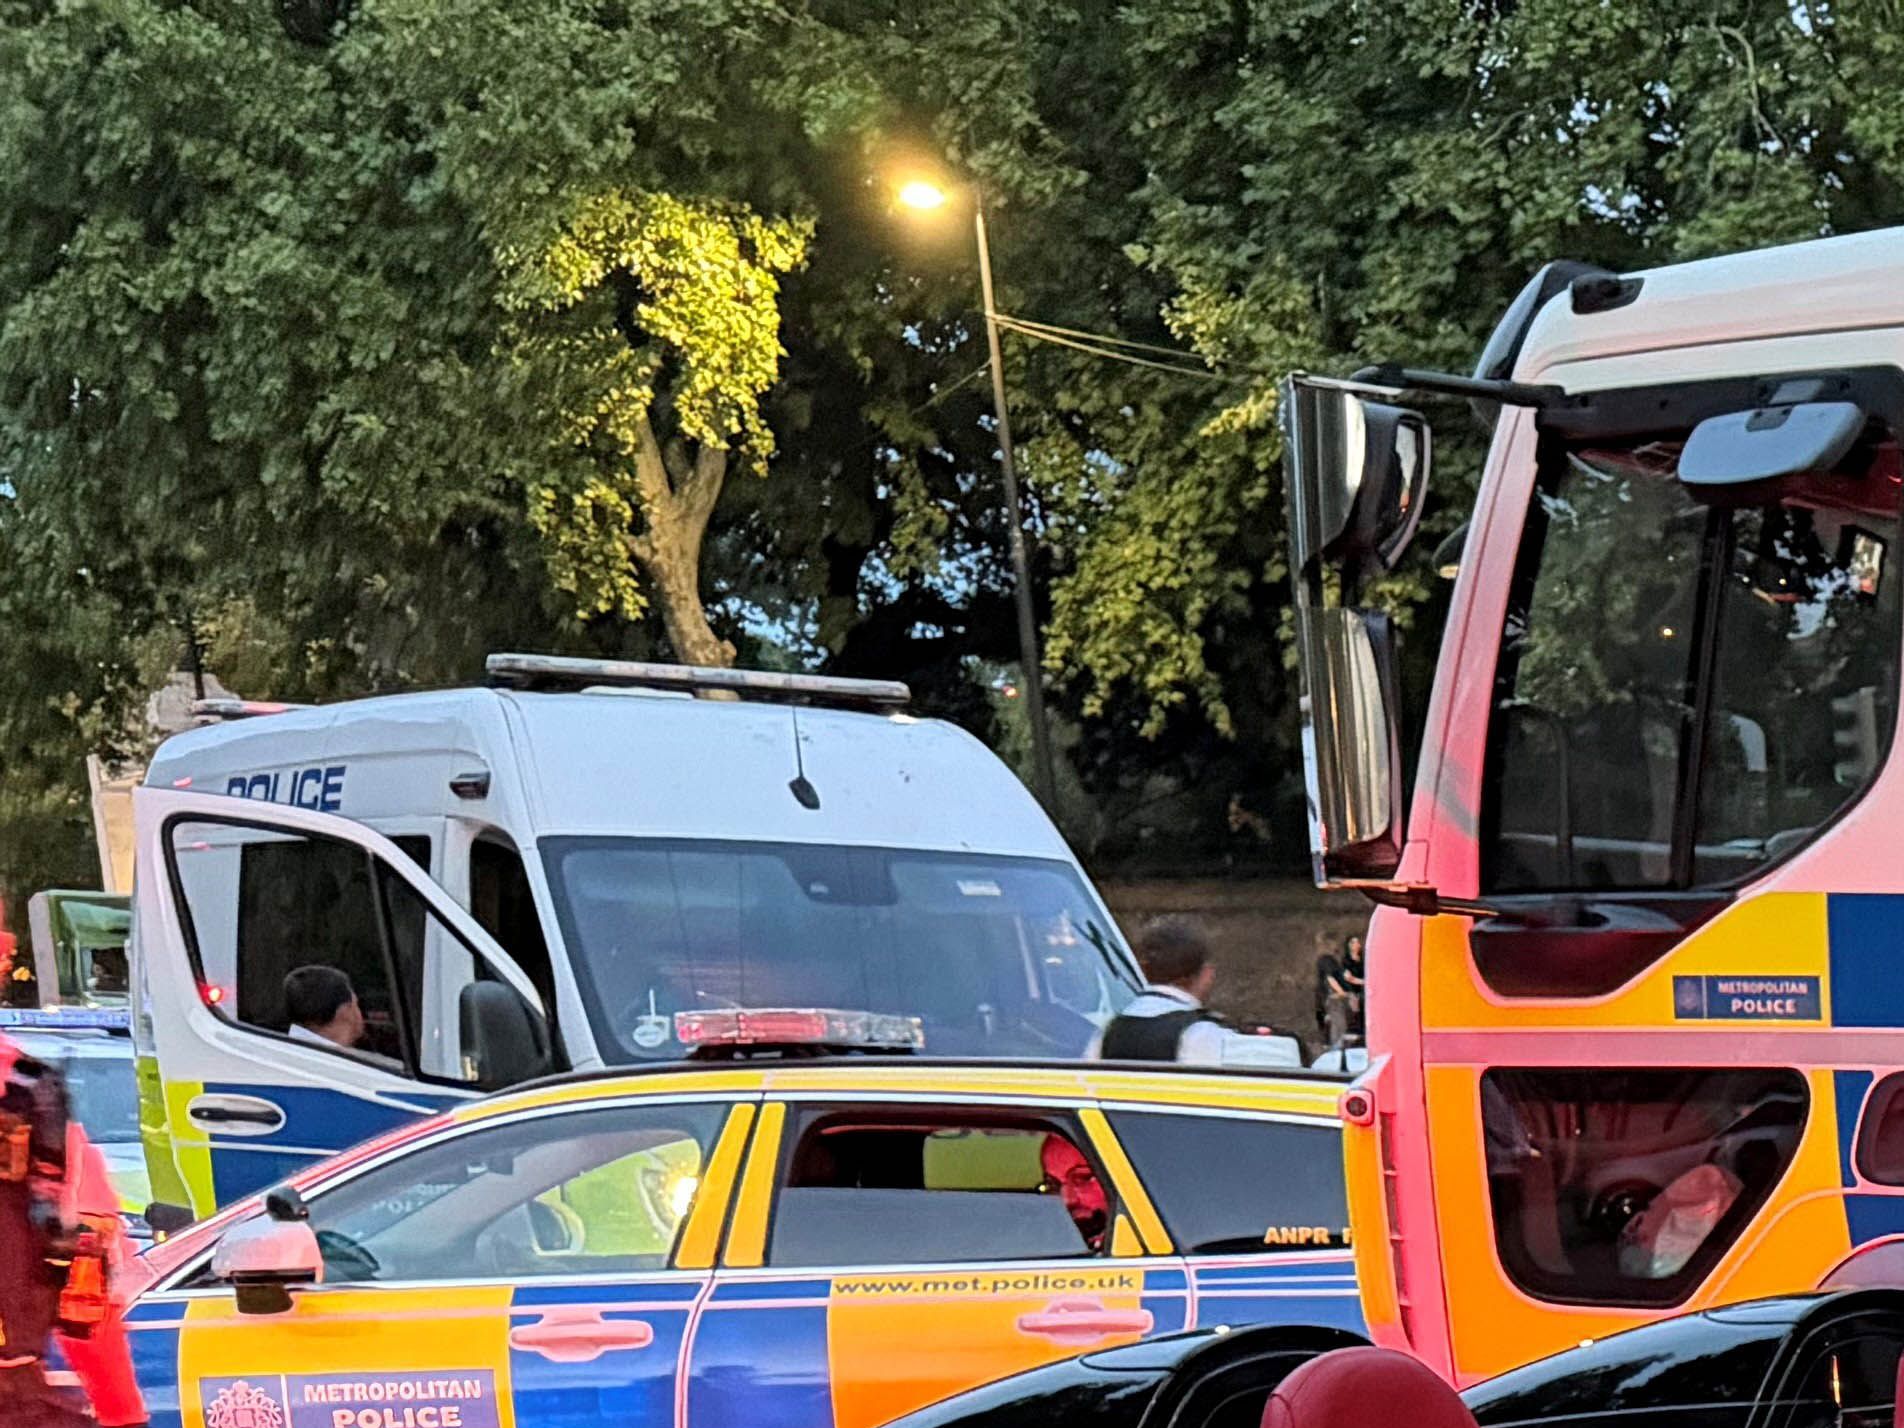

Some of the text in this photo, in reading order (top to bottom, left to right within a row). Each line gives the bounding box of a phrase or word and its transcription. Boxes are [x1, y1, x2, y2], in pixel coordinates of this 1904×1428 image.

[1718, 981, 1808, 994] METROPOLITAN
[1731, 998, 1796, 1014] POLICE
[1264, 1226, 1330, 1244] ANPR
[836, 1274, 1134, 1293] www.met.police.uk
[304, 1379, 482, 1403] METROPOLITAN
